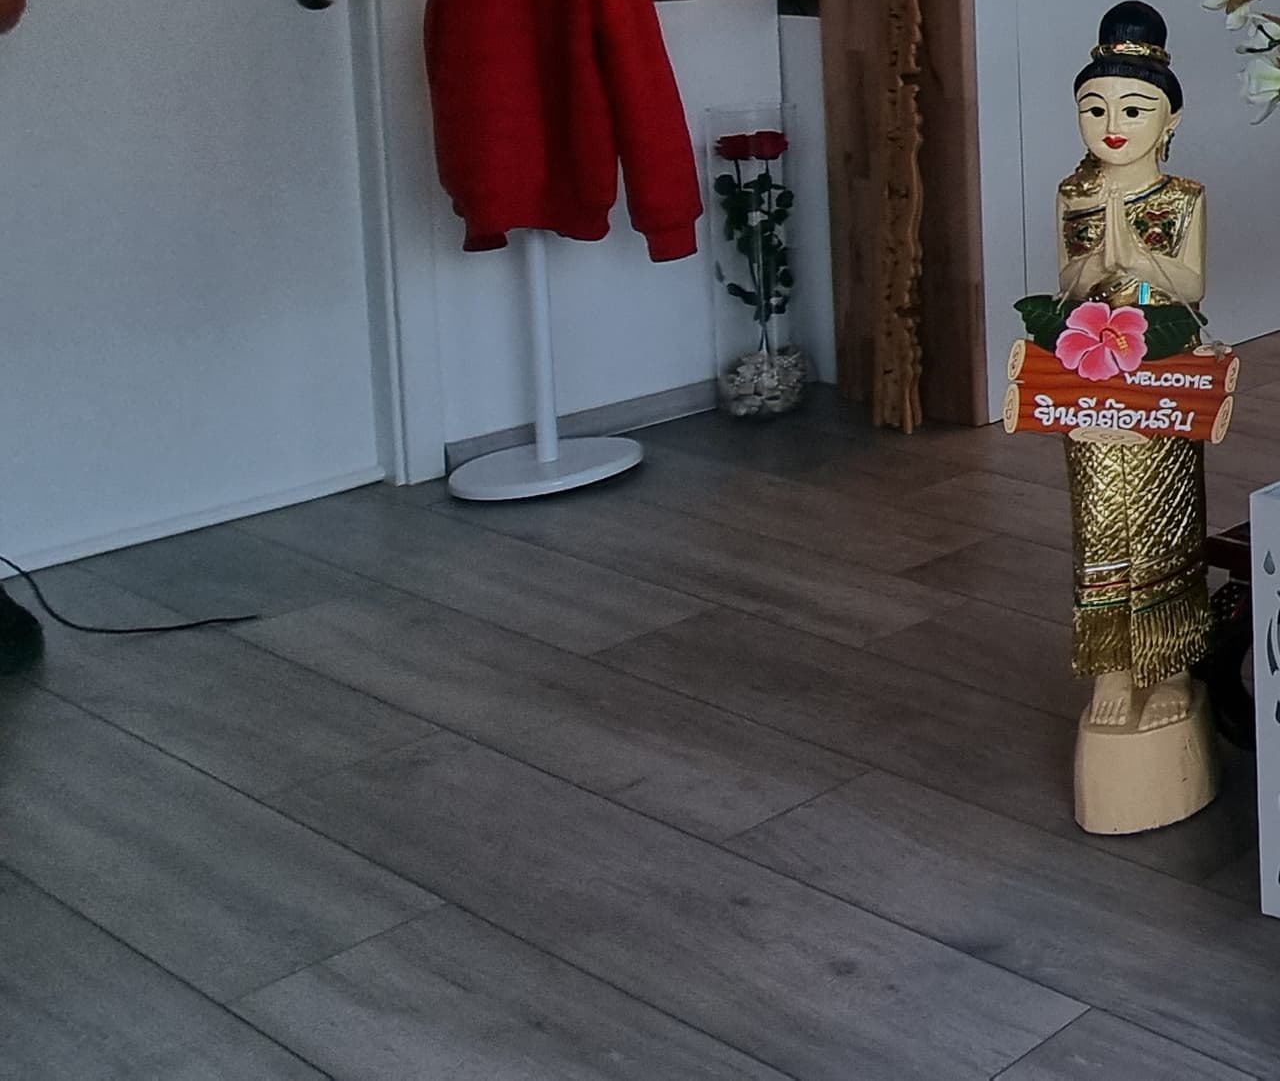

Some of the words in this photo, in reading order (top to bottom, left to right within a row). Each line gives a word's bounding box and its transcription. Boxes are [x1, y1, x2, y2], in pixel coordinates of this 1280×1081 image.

[1124, 371, 1213, 390] WELCOME
[1033, 394, 1195, 432] ยินดีต้อนรับ
